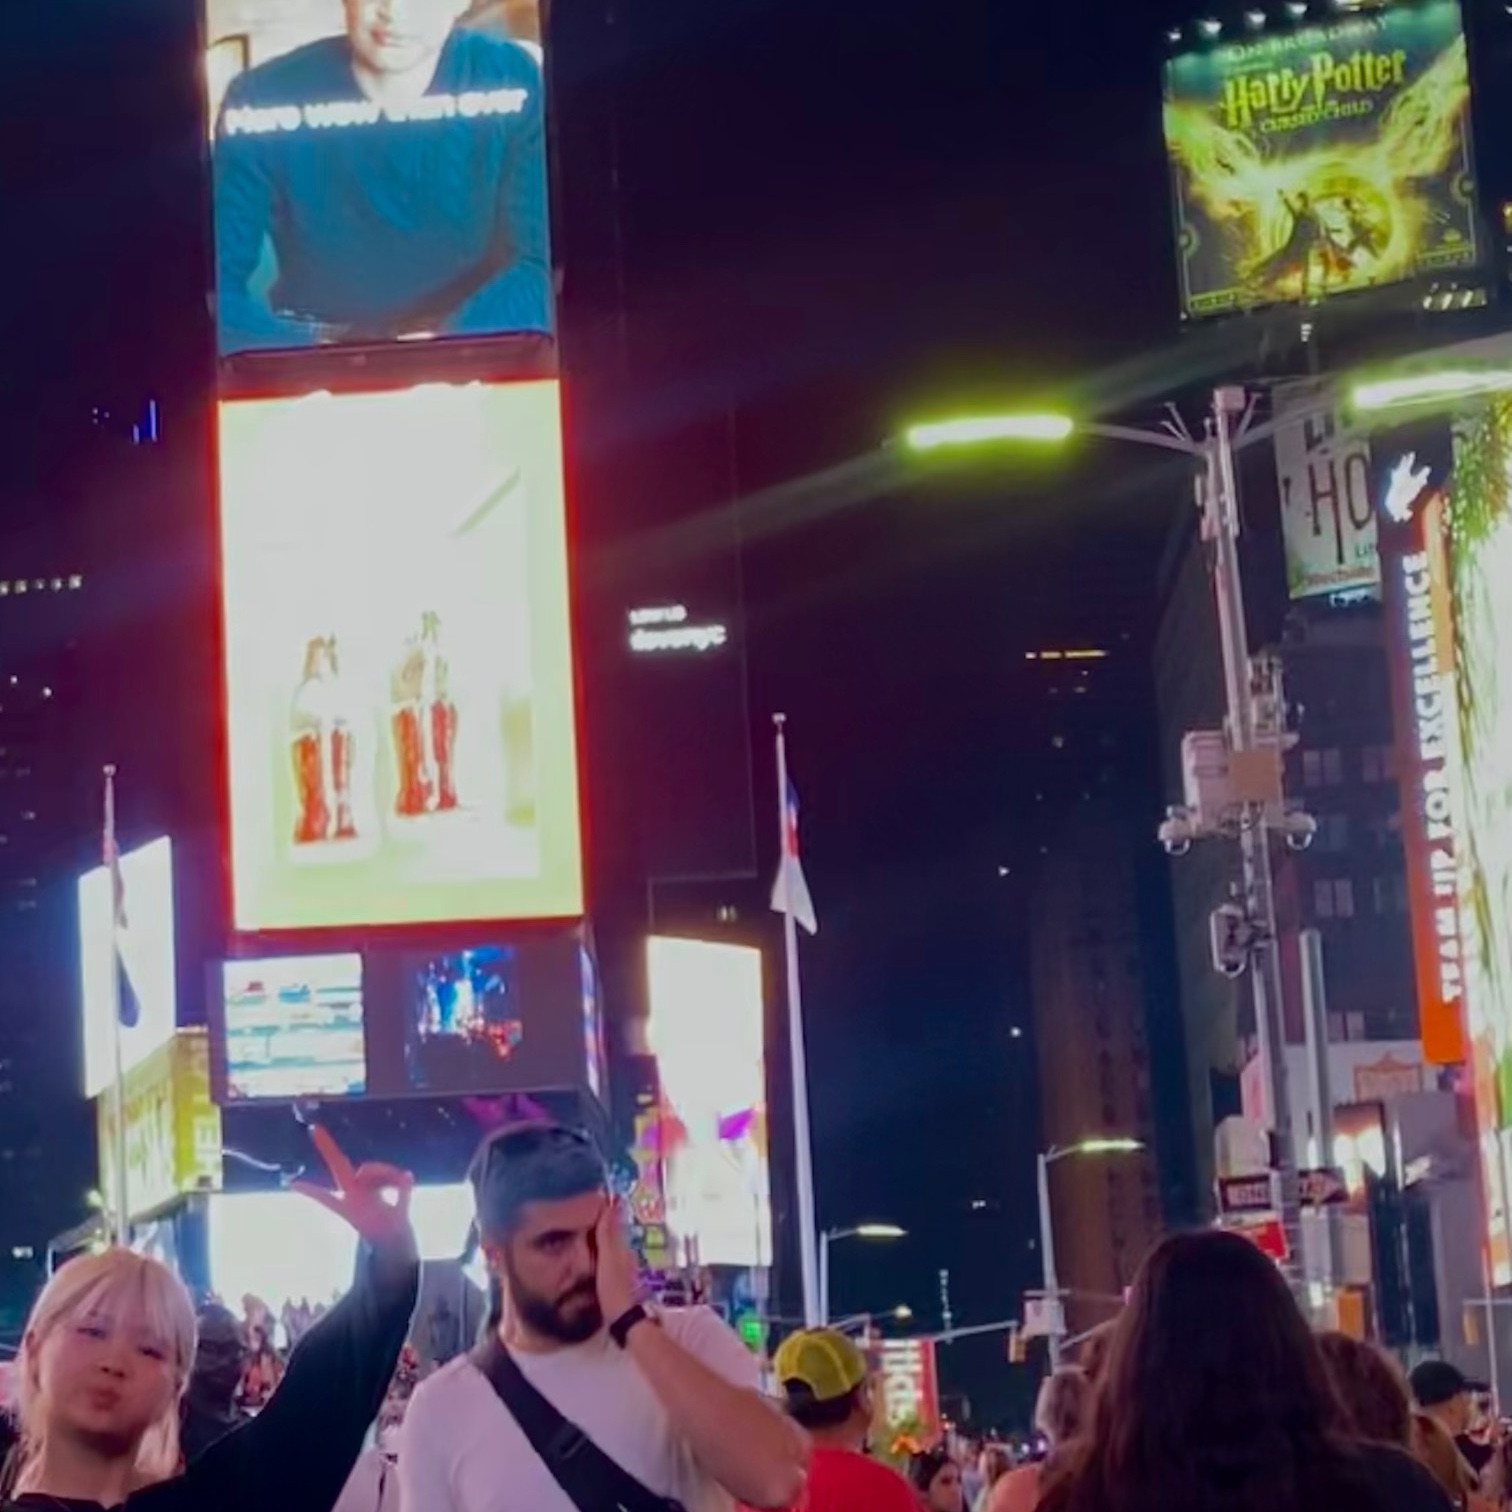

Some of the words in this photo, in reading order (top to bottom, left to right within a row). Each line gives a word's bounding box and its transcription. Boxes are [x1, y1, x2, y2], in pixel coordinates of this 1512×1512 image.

[1222, 67, 1310, 130] Harry
[1310, 49, 1406, 112] Potter
[1402, 550, 1445, 760] EXCELLENCE
[1423, 767, 1453, 841] FOR
[1436, 906, 1464, 1004] TEAM
